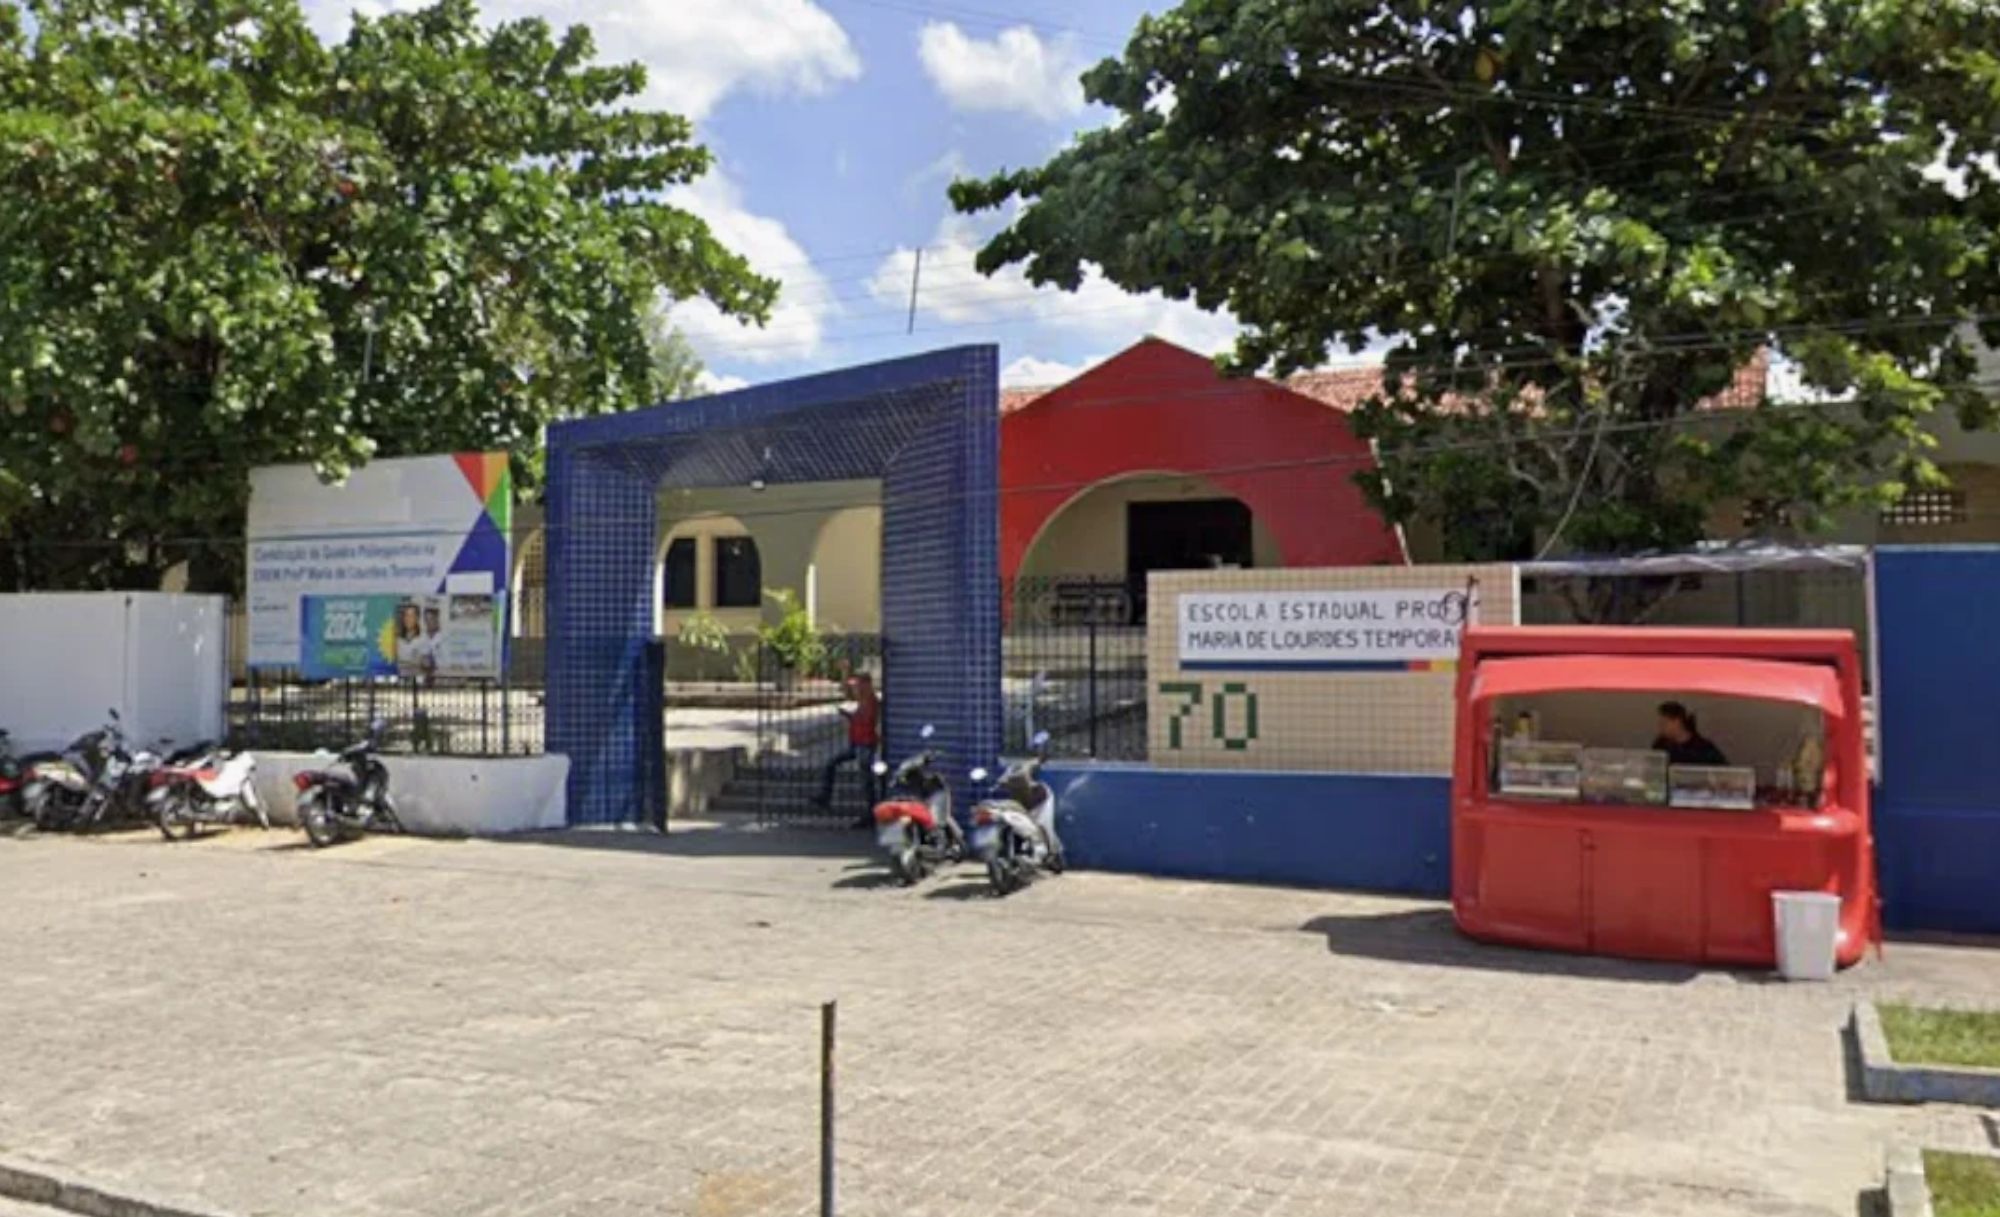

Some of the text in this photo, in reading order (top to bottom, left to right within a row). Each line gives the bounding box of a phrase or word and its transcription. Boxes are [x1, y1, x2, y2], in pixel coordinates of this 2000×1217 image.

[1188, 602, 1267, 622] ESCOLA
[1280, 600, 1385, 621] ESTADUAL
[324, 612, 367, 640] 2024
[1187, 628, 1457, 650] MARIA DE LOURDES TEMPORA
[1157, 681, 1257, 750] 70
